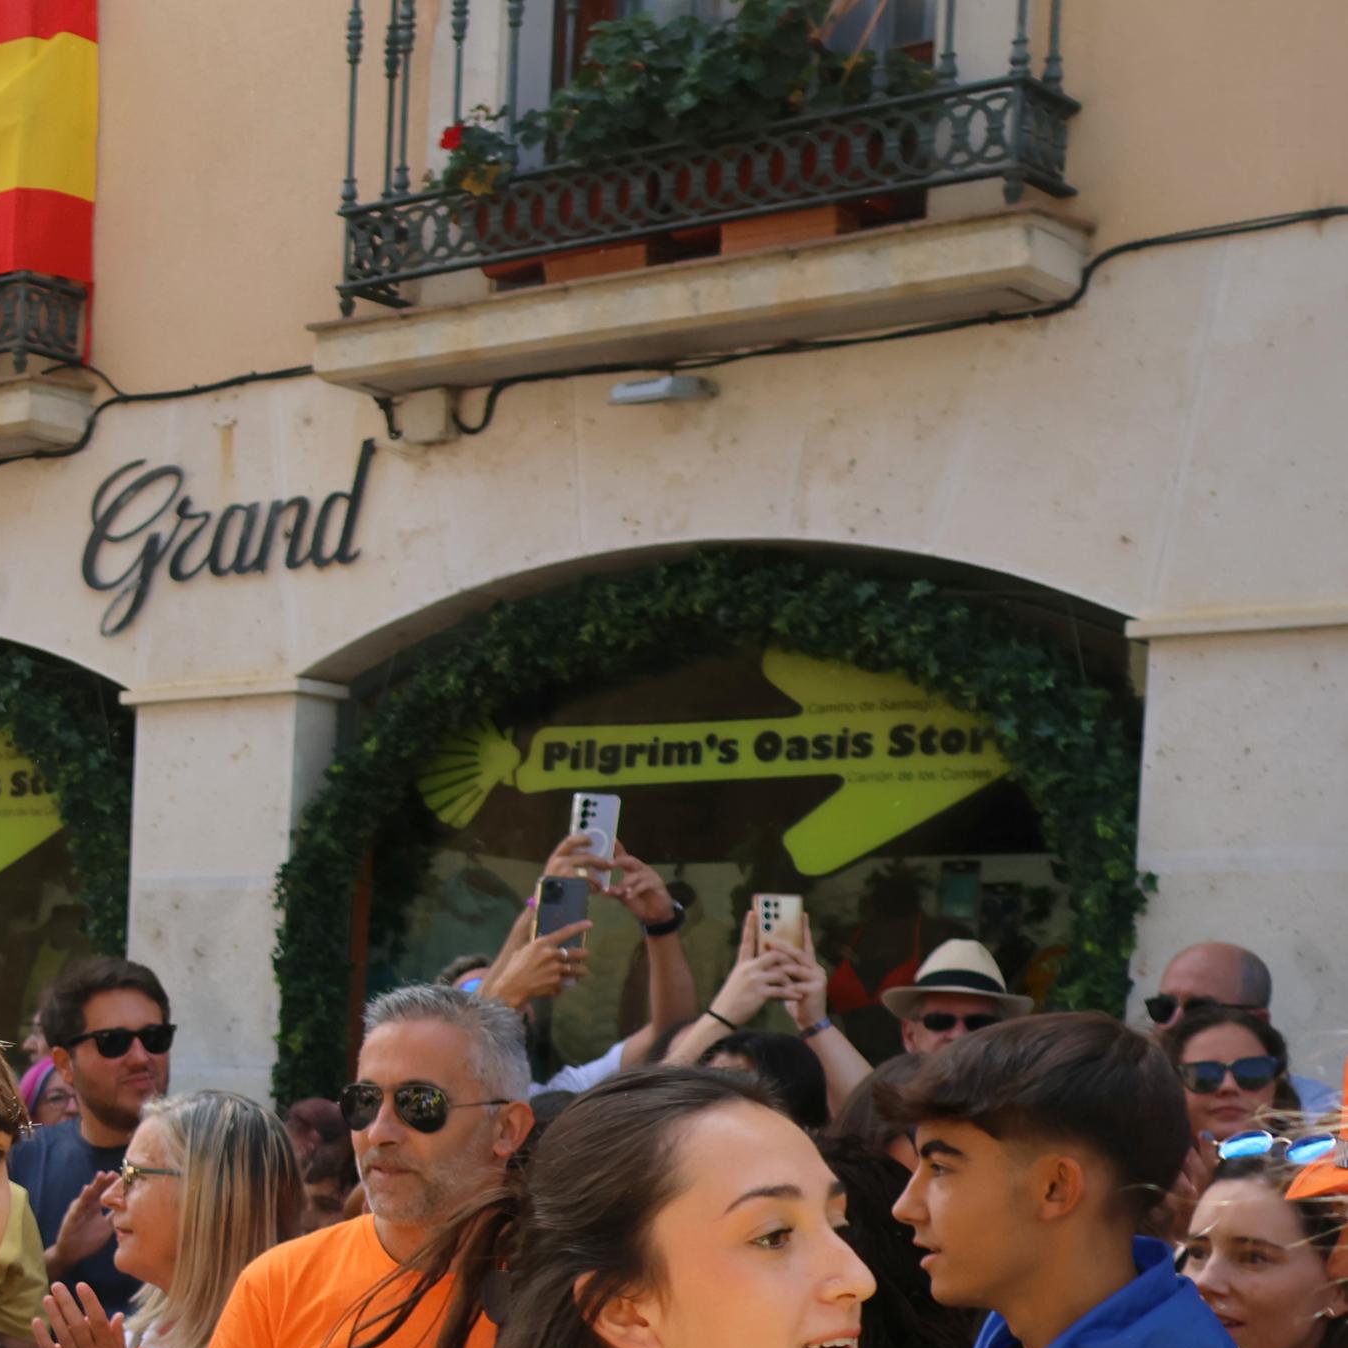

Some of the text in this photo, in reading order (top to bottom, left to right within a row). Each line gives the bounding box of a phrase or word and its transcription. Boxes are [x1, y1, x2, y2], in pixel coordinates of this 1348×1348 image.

[81, 437, 376, 637] Grand
[542, 731, 739, 774] Pilgrim's
[753, 727, 874, 761] Oasis
